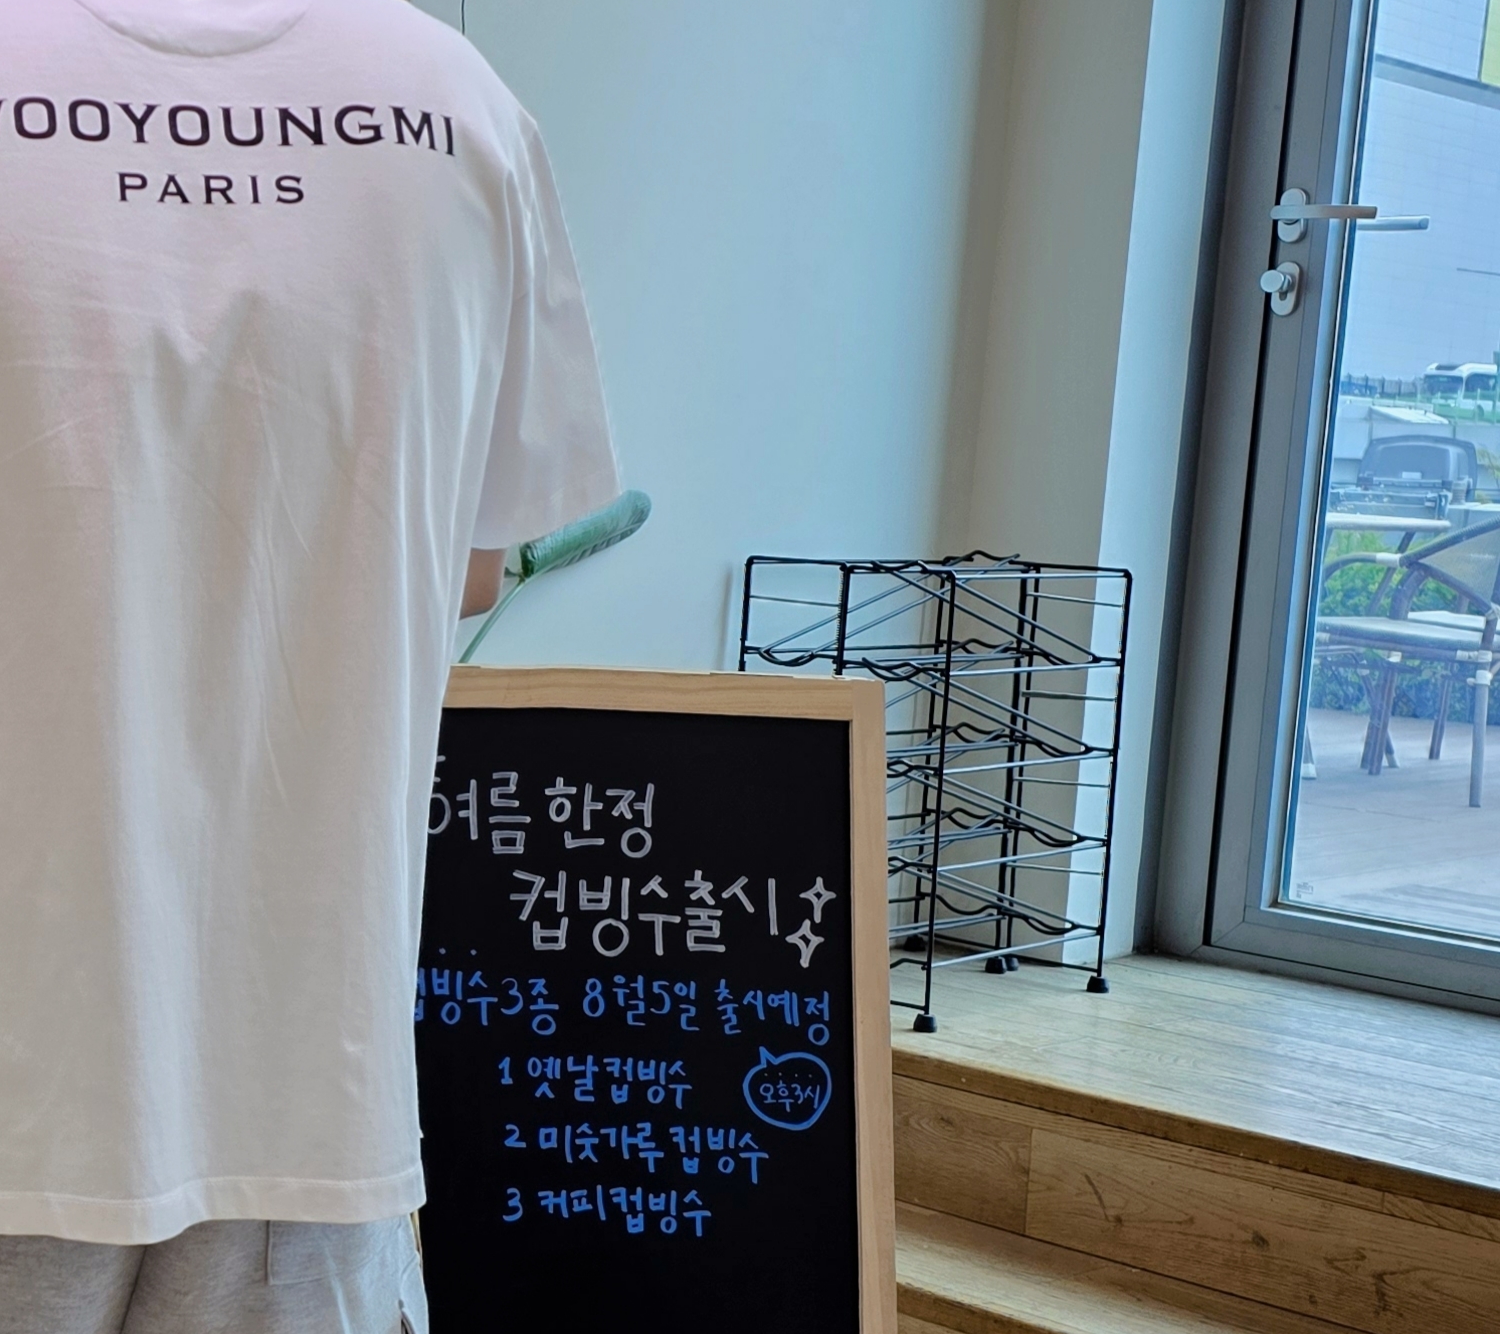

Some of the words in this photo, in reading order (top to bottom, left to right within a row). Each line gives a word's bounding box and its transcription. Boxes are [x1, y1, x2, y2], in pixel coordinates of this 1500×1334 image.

[117, 171, 304, 205] PARIS
[428, 772, 531, 854] 여름
[545, 777, 655, 858] 한정
[714, 979, 830, 1045] 출시예정
[498, 1056, 513, 1085] 1
[504, 1125, 526, 1148] 2
[503, 1188, 524, 1222] 3
